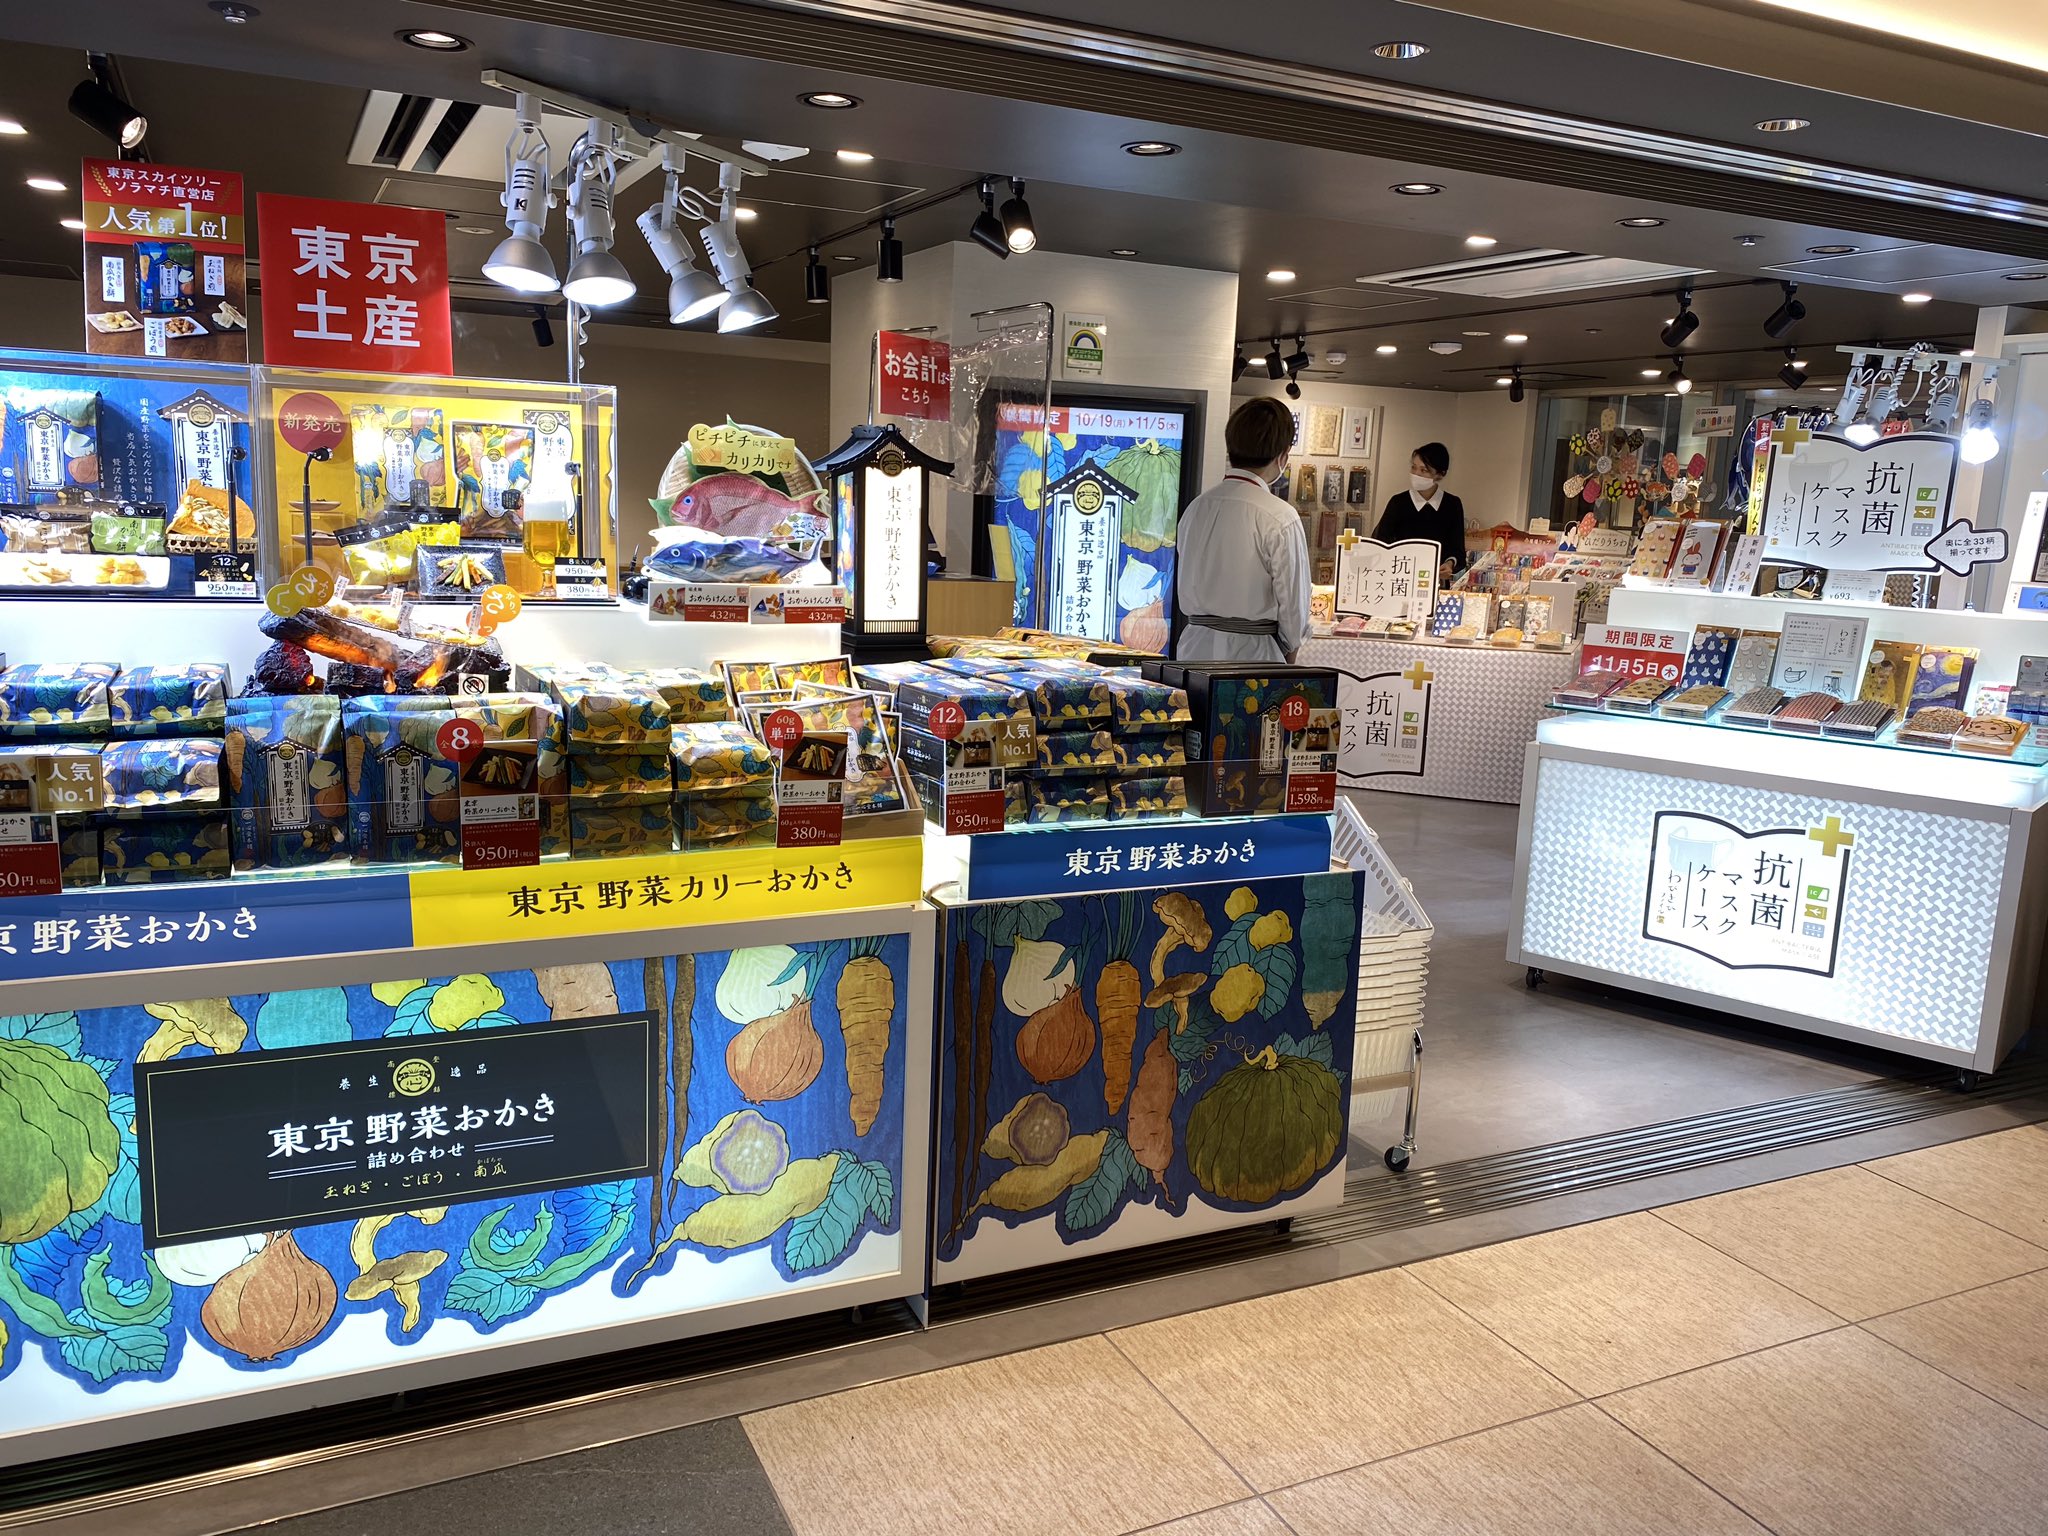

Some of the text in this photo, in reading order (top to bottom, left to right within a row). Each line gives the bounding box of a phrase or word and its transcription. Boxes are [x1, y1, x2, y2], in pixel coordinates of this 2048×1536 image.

[106, 166, 221, 187] 東京スカイツリー
[114, 181, 215, 202] ソラマチ直営店
[291, 225, 421, 284] 東京
[293, 289, 421, 349] 土産
[901, 387, 930, 404] こちら
[283, 412, 342, 434] 新発売
[1861, 461, 1905, 536] 抗菌
[1804, 482, 1830, 546] ケース
[1829, 486, 1856, 549] マスク
[1361, 567, 1373, 604] ケース
[1389, 555, 1412, 597] 抗菌
[1374, 569, 1387, 605] マスク
[709, 610, 736, 620] 432円
[808, 612, 834, 621] 432円
[1605, 629, 1675, 650] 期間限定
[775, 715, 796, 725] 60g
[1365, 690, 1394, 747] 抗菌
[769, 727, 797, 741] 単品
[1002, 724, 1032, 740] 人気
[1343, 708, 1360, 756] マスク
[1003, 744, 1032, 757] No.1
[46, 762, 95, 782] 人気
[47, 787, 95, 803] No.1
[1289, 792, 1324, 806] 1,598円
[955, 813, 989, 828] 950円
[790, 826, 827, 840] 380円
[475, 846, 518, 861] 950円
[1692, 864, 1716, 931] ケース
[1750, 850, 1793, 930] 抗菌
[1717, 872, 1743, 936] マスク
[366, 1142, 466, 1170] 詰め合わせ
